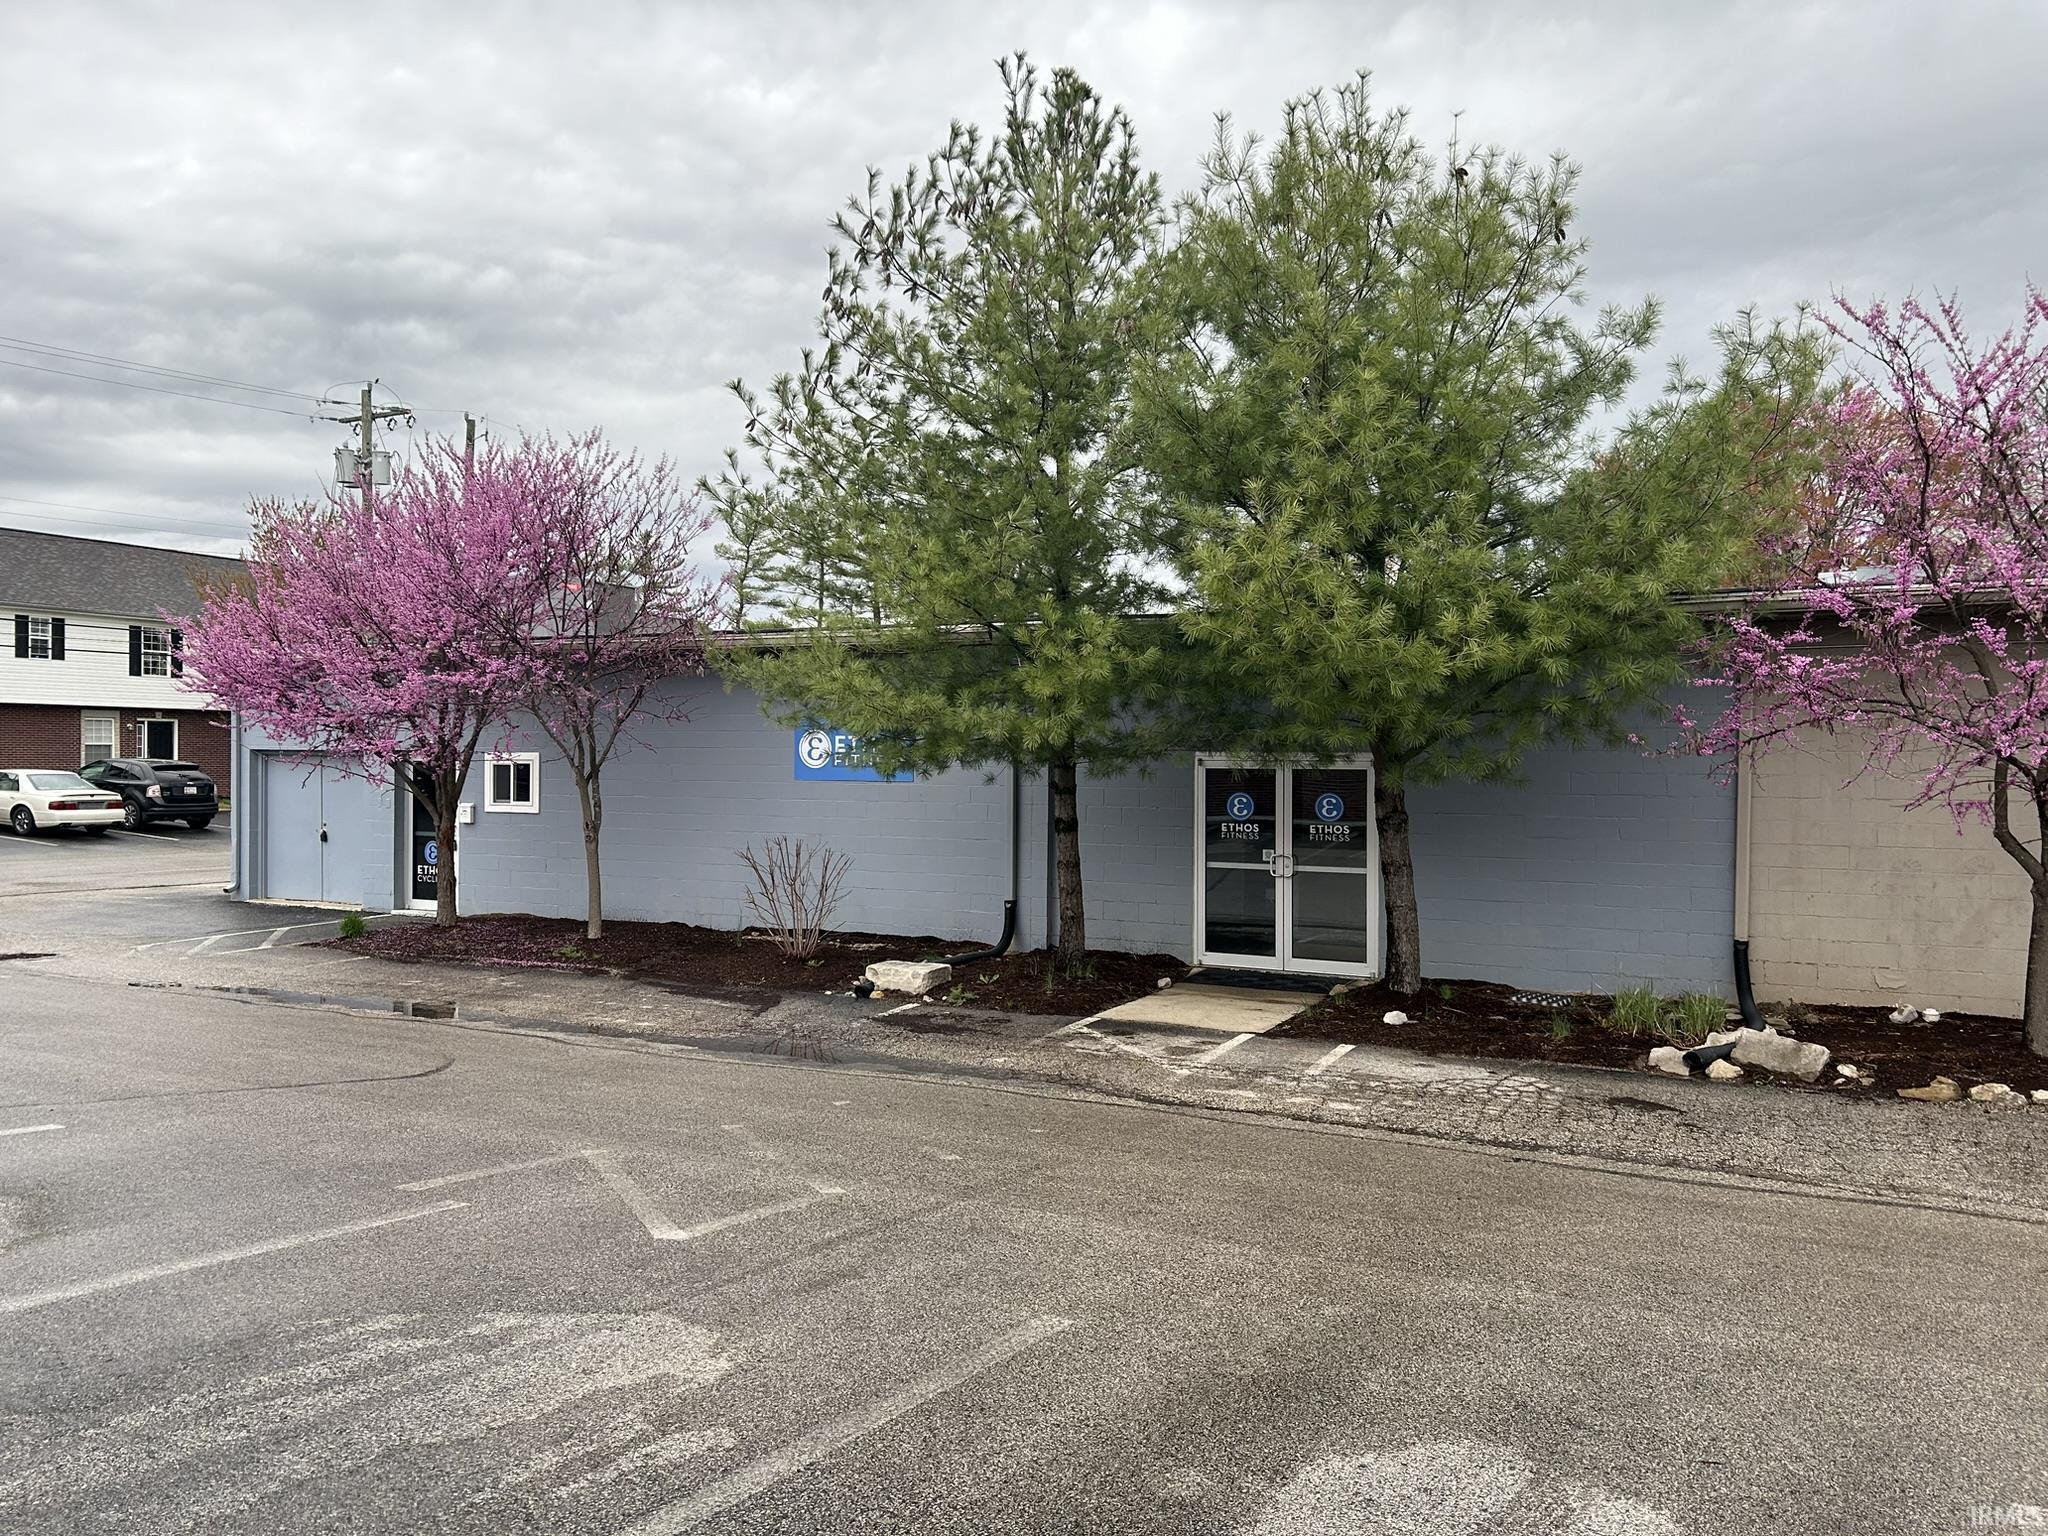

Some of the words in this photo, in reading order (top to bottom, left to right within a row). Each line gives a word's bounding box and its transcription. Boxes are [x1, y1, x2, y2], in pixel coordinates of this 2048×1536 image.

[1221, 823, 1260, 833] ETHOS
[1309, 824, 1350, 834] ETHOS
[1221, 832, 1260, 840] FITNESS
[1309, 833, 1351, 842] FITNESS
[417, 865, 438, 875] ETH
